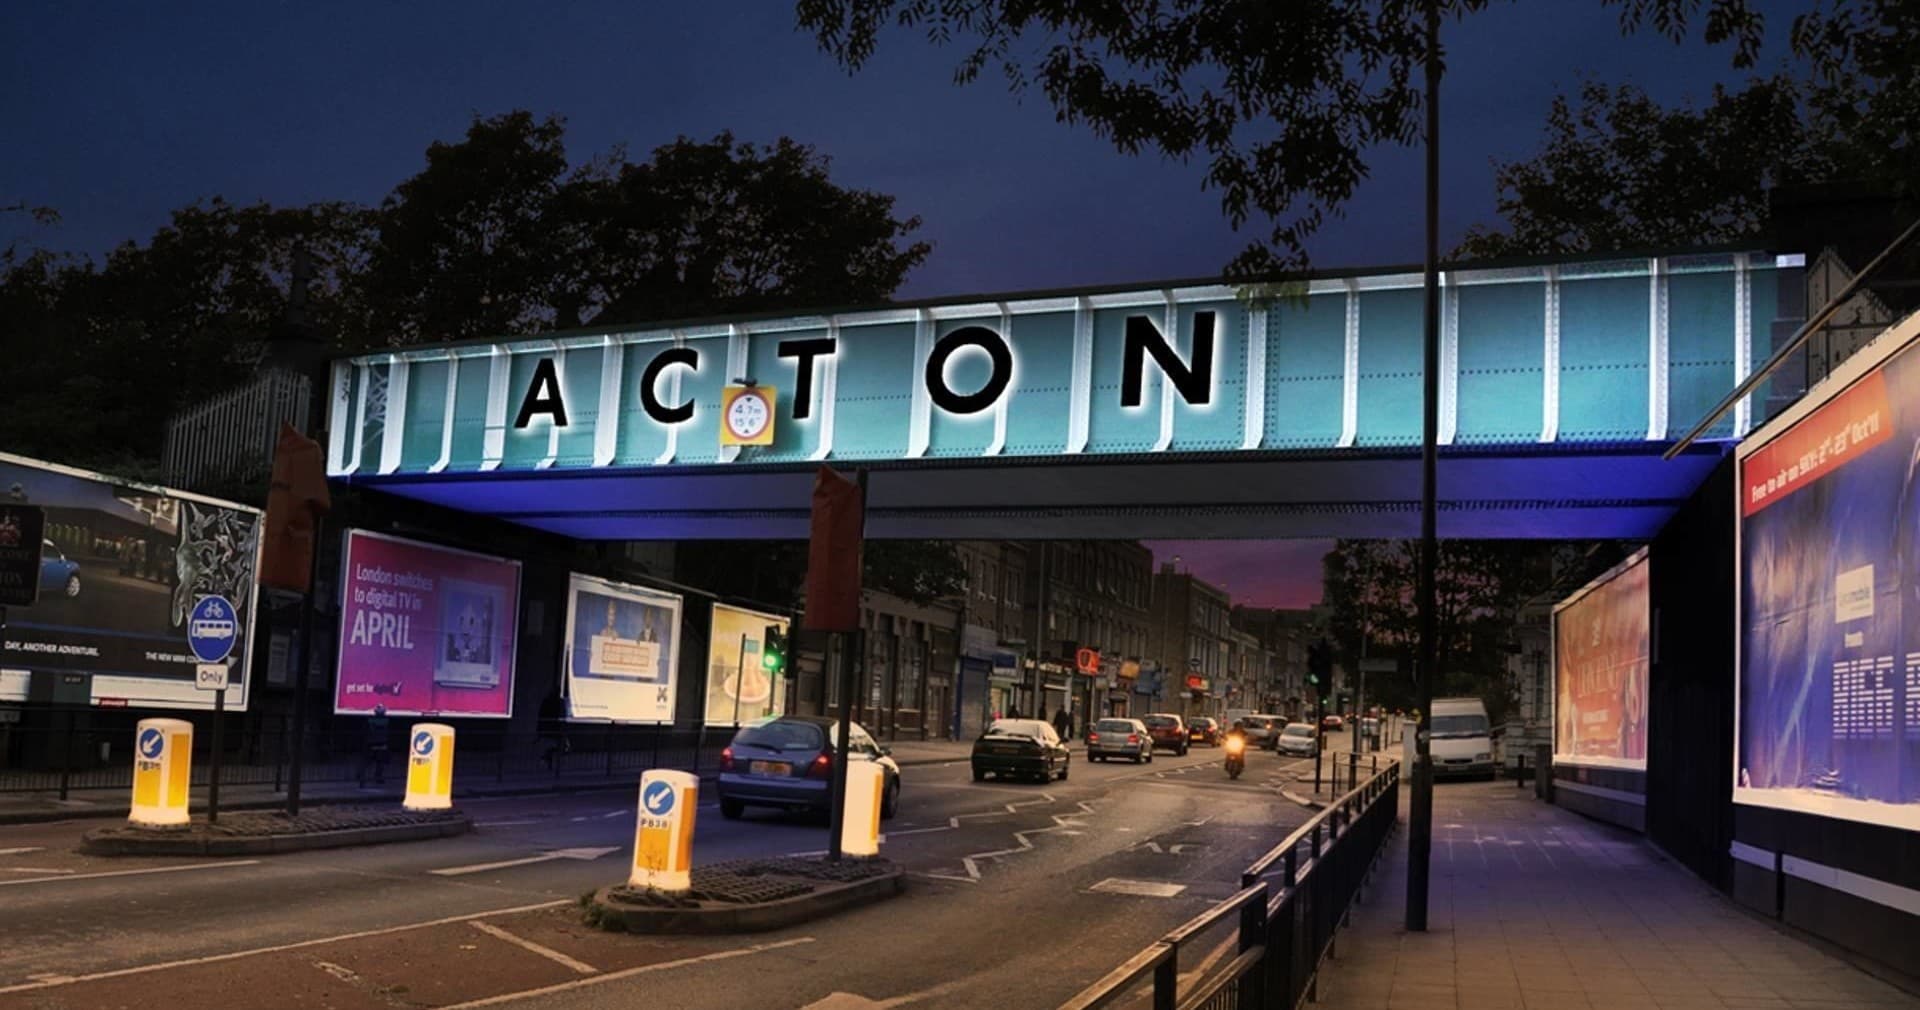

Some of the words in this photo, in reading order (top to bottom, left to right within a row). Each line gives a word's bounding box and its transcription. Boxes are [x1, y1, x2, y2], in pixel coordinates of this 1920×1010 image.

[513, 310, 1216, 428] ACTON
[356, 563, 393, 584] London
[355, 586, 365, 603] to
[366, 587, 397, 610] digital
[399, 591, 412, 609] TV
[350, 609, 415, 649] APRIL
[23, 642, 57, 654] ANOTHER
[200, 670, 223, 685] Only
